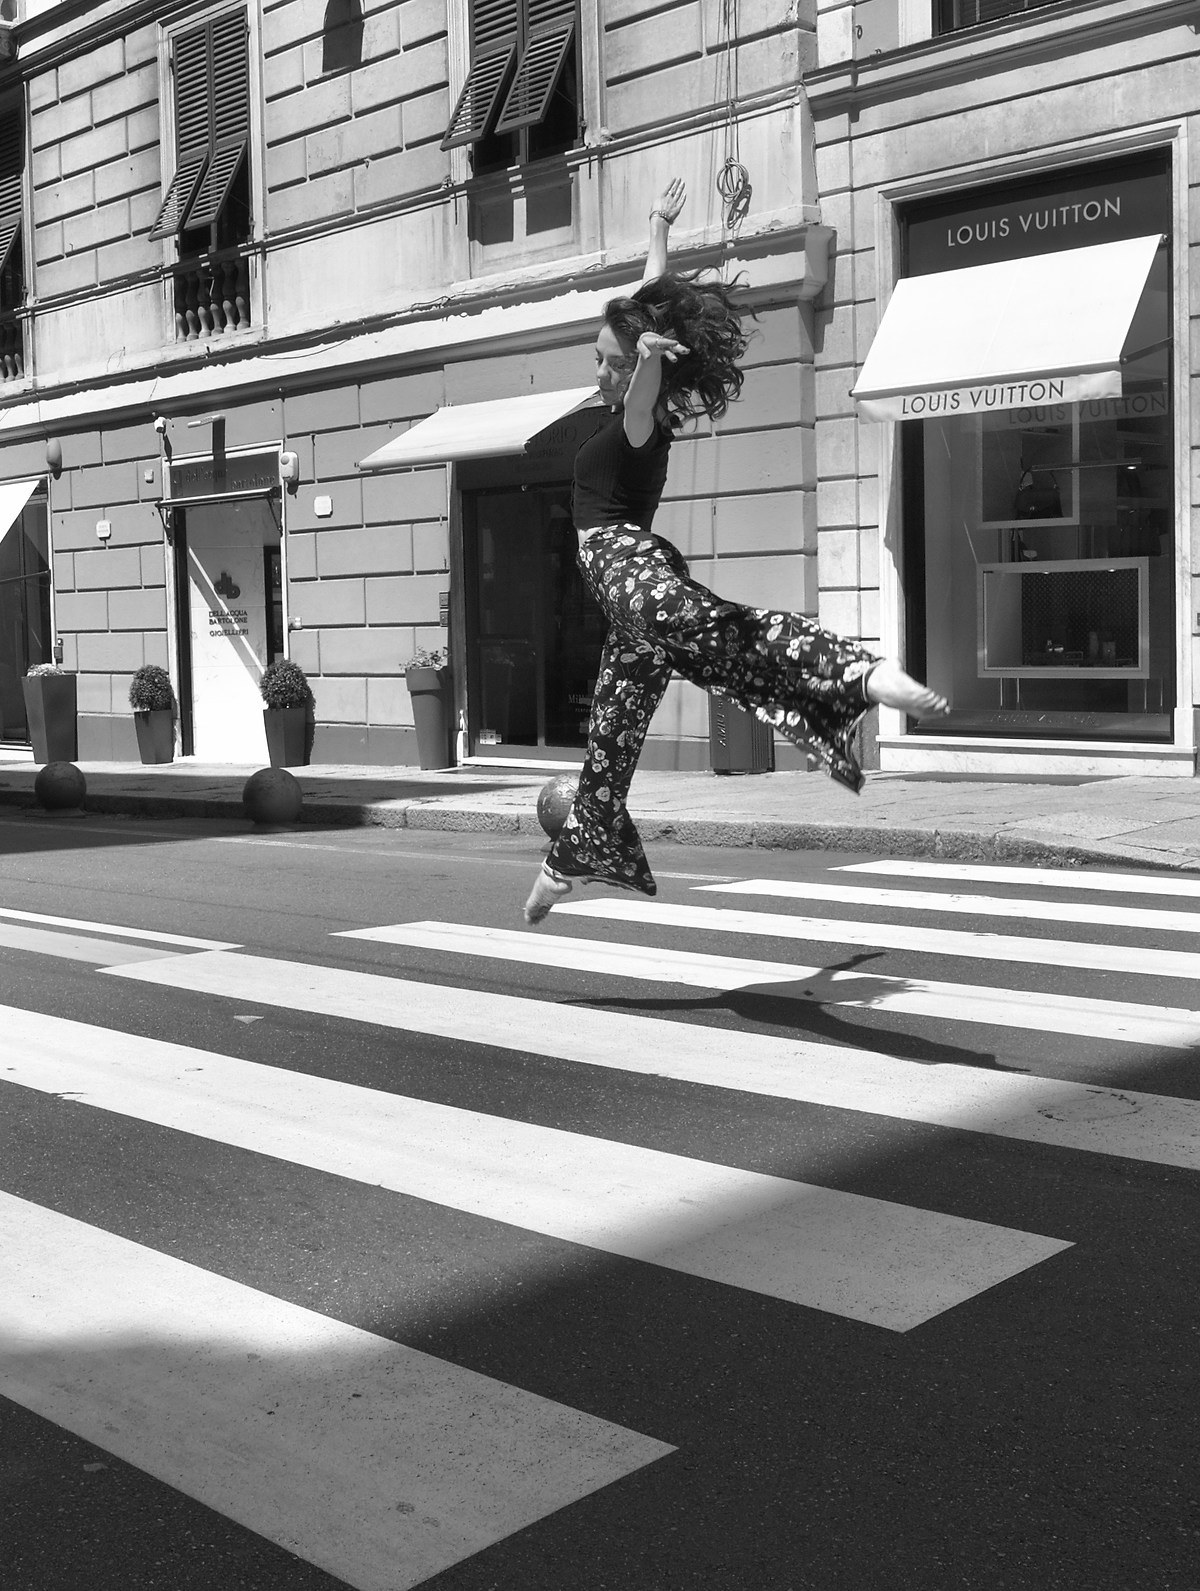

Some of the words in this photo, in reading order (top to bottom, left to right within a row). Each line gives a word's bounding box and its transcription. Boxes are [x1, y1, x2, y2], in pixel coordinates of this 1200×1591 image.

[948, 218, 1010, 247] LOUIS
[1018, 196, 1121, 233] VUITTON
[901, 392, 961, 415] LOUIS
[969, 379, 1064, 408] VUITTON
[1009, 404, 1066, 425] LOUIS
